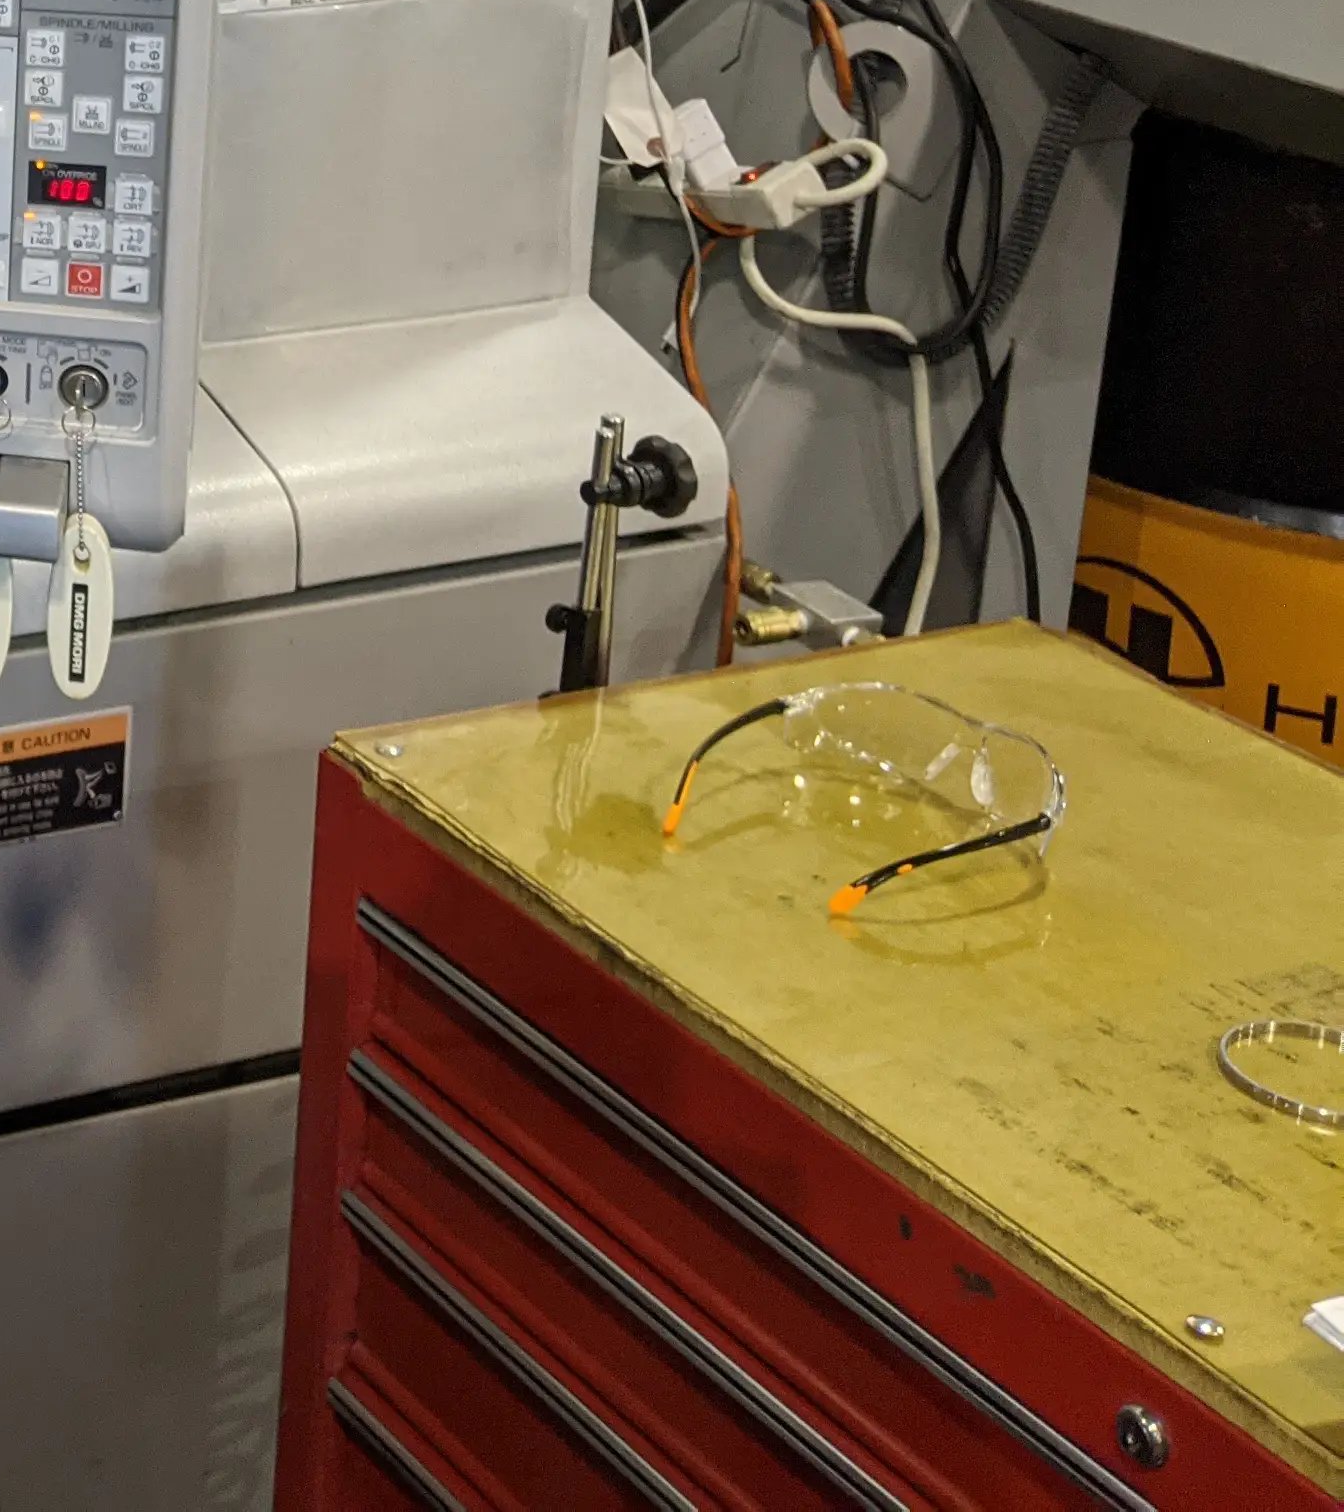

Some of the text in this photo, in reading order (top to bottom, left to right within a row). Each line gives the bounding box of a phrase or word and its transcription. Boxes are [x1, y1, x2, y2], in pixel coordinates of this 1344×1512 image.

[39, 16, 154, 33] SPINDLE/MILLING
[72, 285, 98, 293] STOP
[71, 592, 85, 675] DMG MORI
[21, 727, 90, 750] CAUTION
